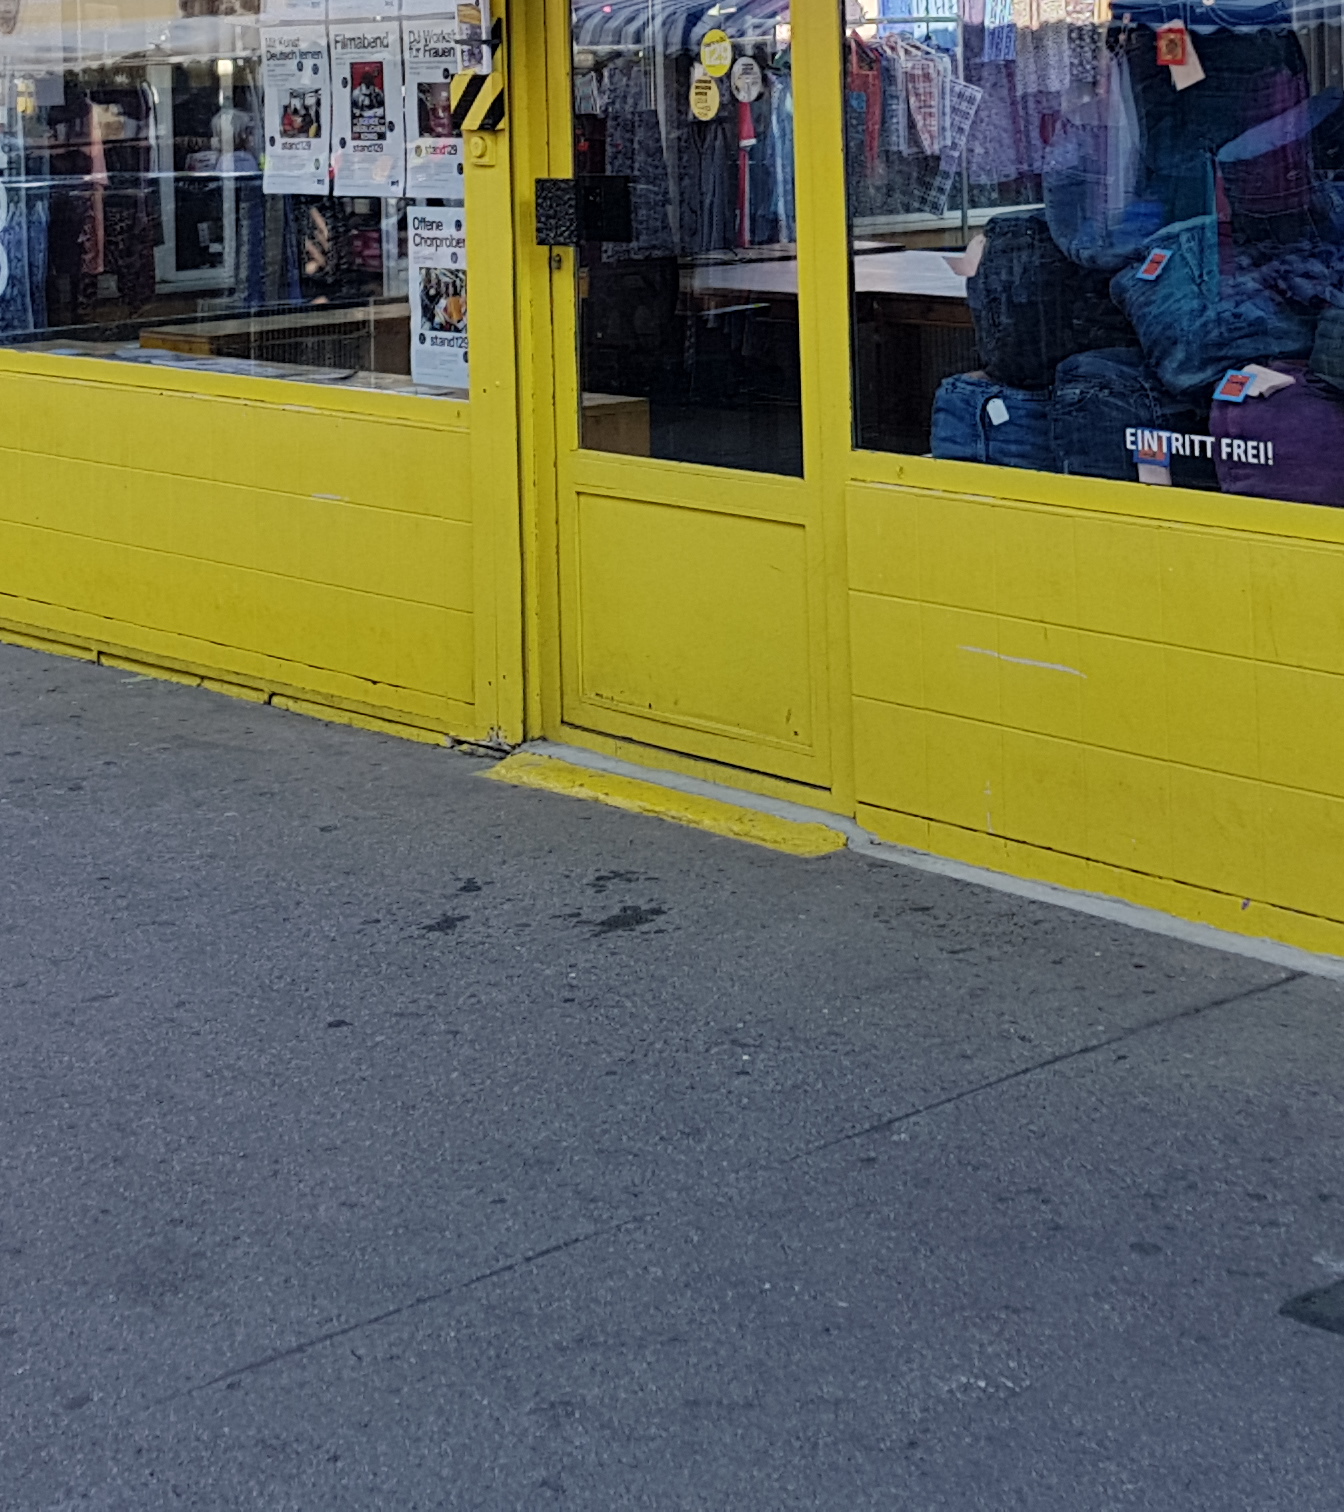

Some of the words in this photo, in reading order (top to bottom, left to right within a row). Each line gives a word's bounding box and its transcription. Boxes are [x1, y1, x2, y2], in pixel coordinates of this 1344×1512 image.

[334, 31, 389, 51] Filmabend
[409, 29, 421, 45] DJ
[266, 49, 297, 61] Deutsch
[298, 48, 324, 60] lernen
[423, 43, 456, 58] Frauen
[412, 216, 444, 231] Offene
[1125, 427, 1215, 459] EINTRITT
[1220, 437, 1274, 466] FREI!
